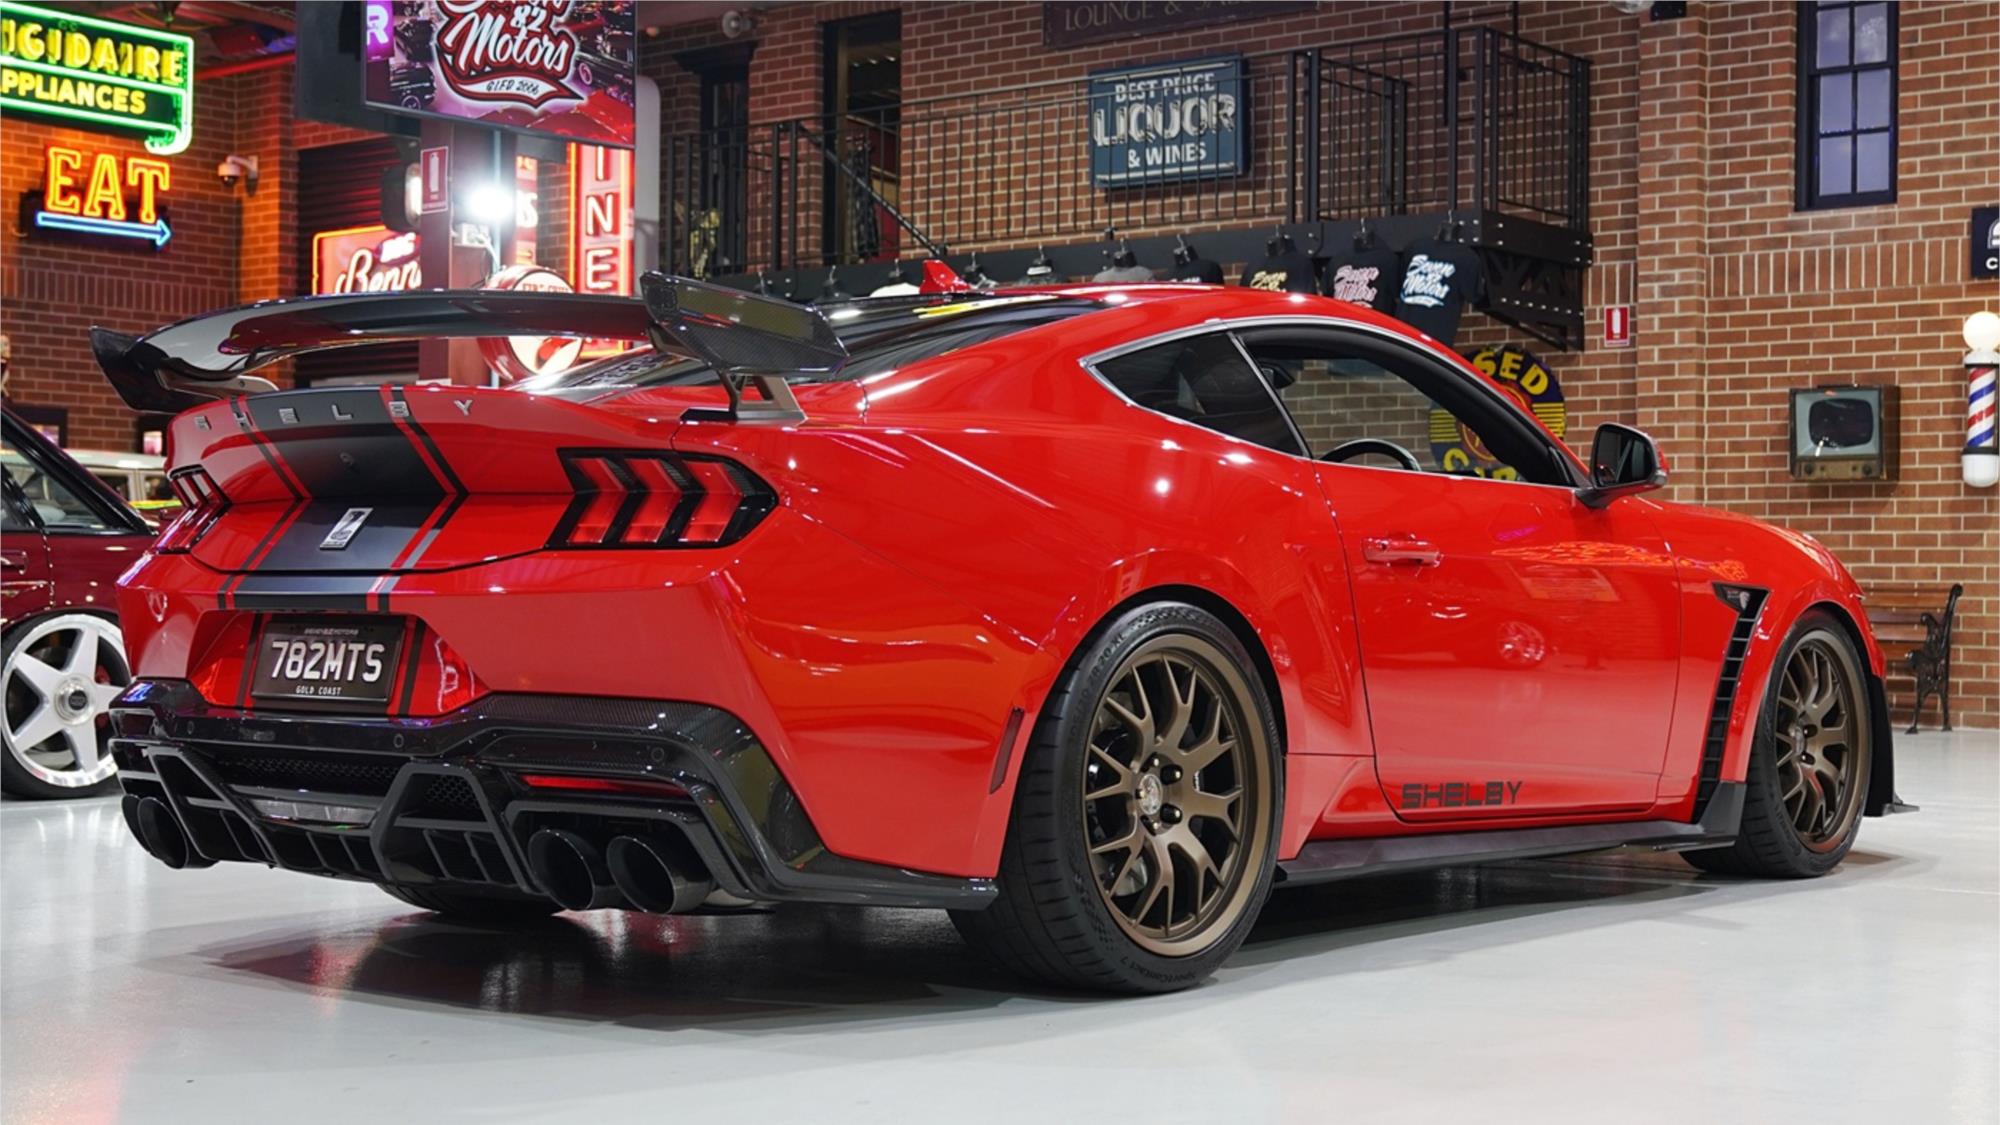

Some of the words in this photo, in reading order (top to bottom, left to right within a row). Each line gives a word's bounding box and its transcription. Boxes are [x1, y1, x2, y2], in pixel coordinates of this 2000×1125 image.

[510, 5, 547, 32] 82
[1065, 0, 1154, 32] LOUNGE
[443, 12, 569, 73] Motors
[0, 68, 146, 115] PPLIANCES
[1115, 80, 1158, 103] BEST
[1162, 73, 1215, 97] PRICE
[1094, 93, 1235, 147] LIQUOR
[1128, 149, 1141, 168] &
[1145, 142, 1207, 166] WINES
[47, 147, 170, 224] EAT
[585, 143, 616, 294] INE
[194, 399, 473, 431] SHELBY
[271, 641, 386, 683] 782MTS
[296, 685, 314, 696] GOLD
[318, 686, 342, 696] COAST
[1401, 781, 1523, 809] SHELBY
